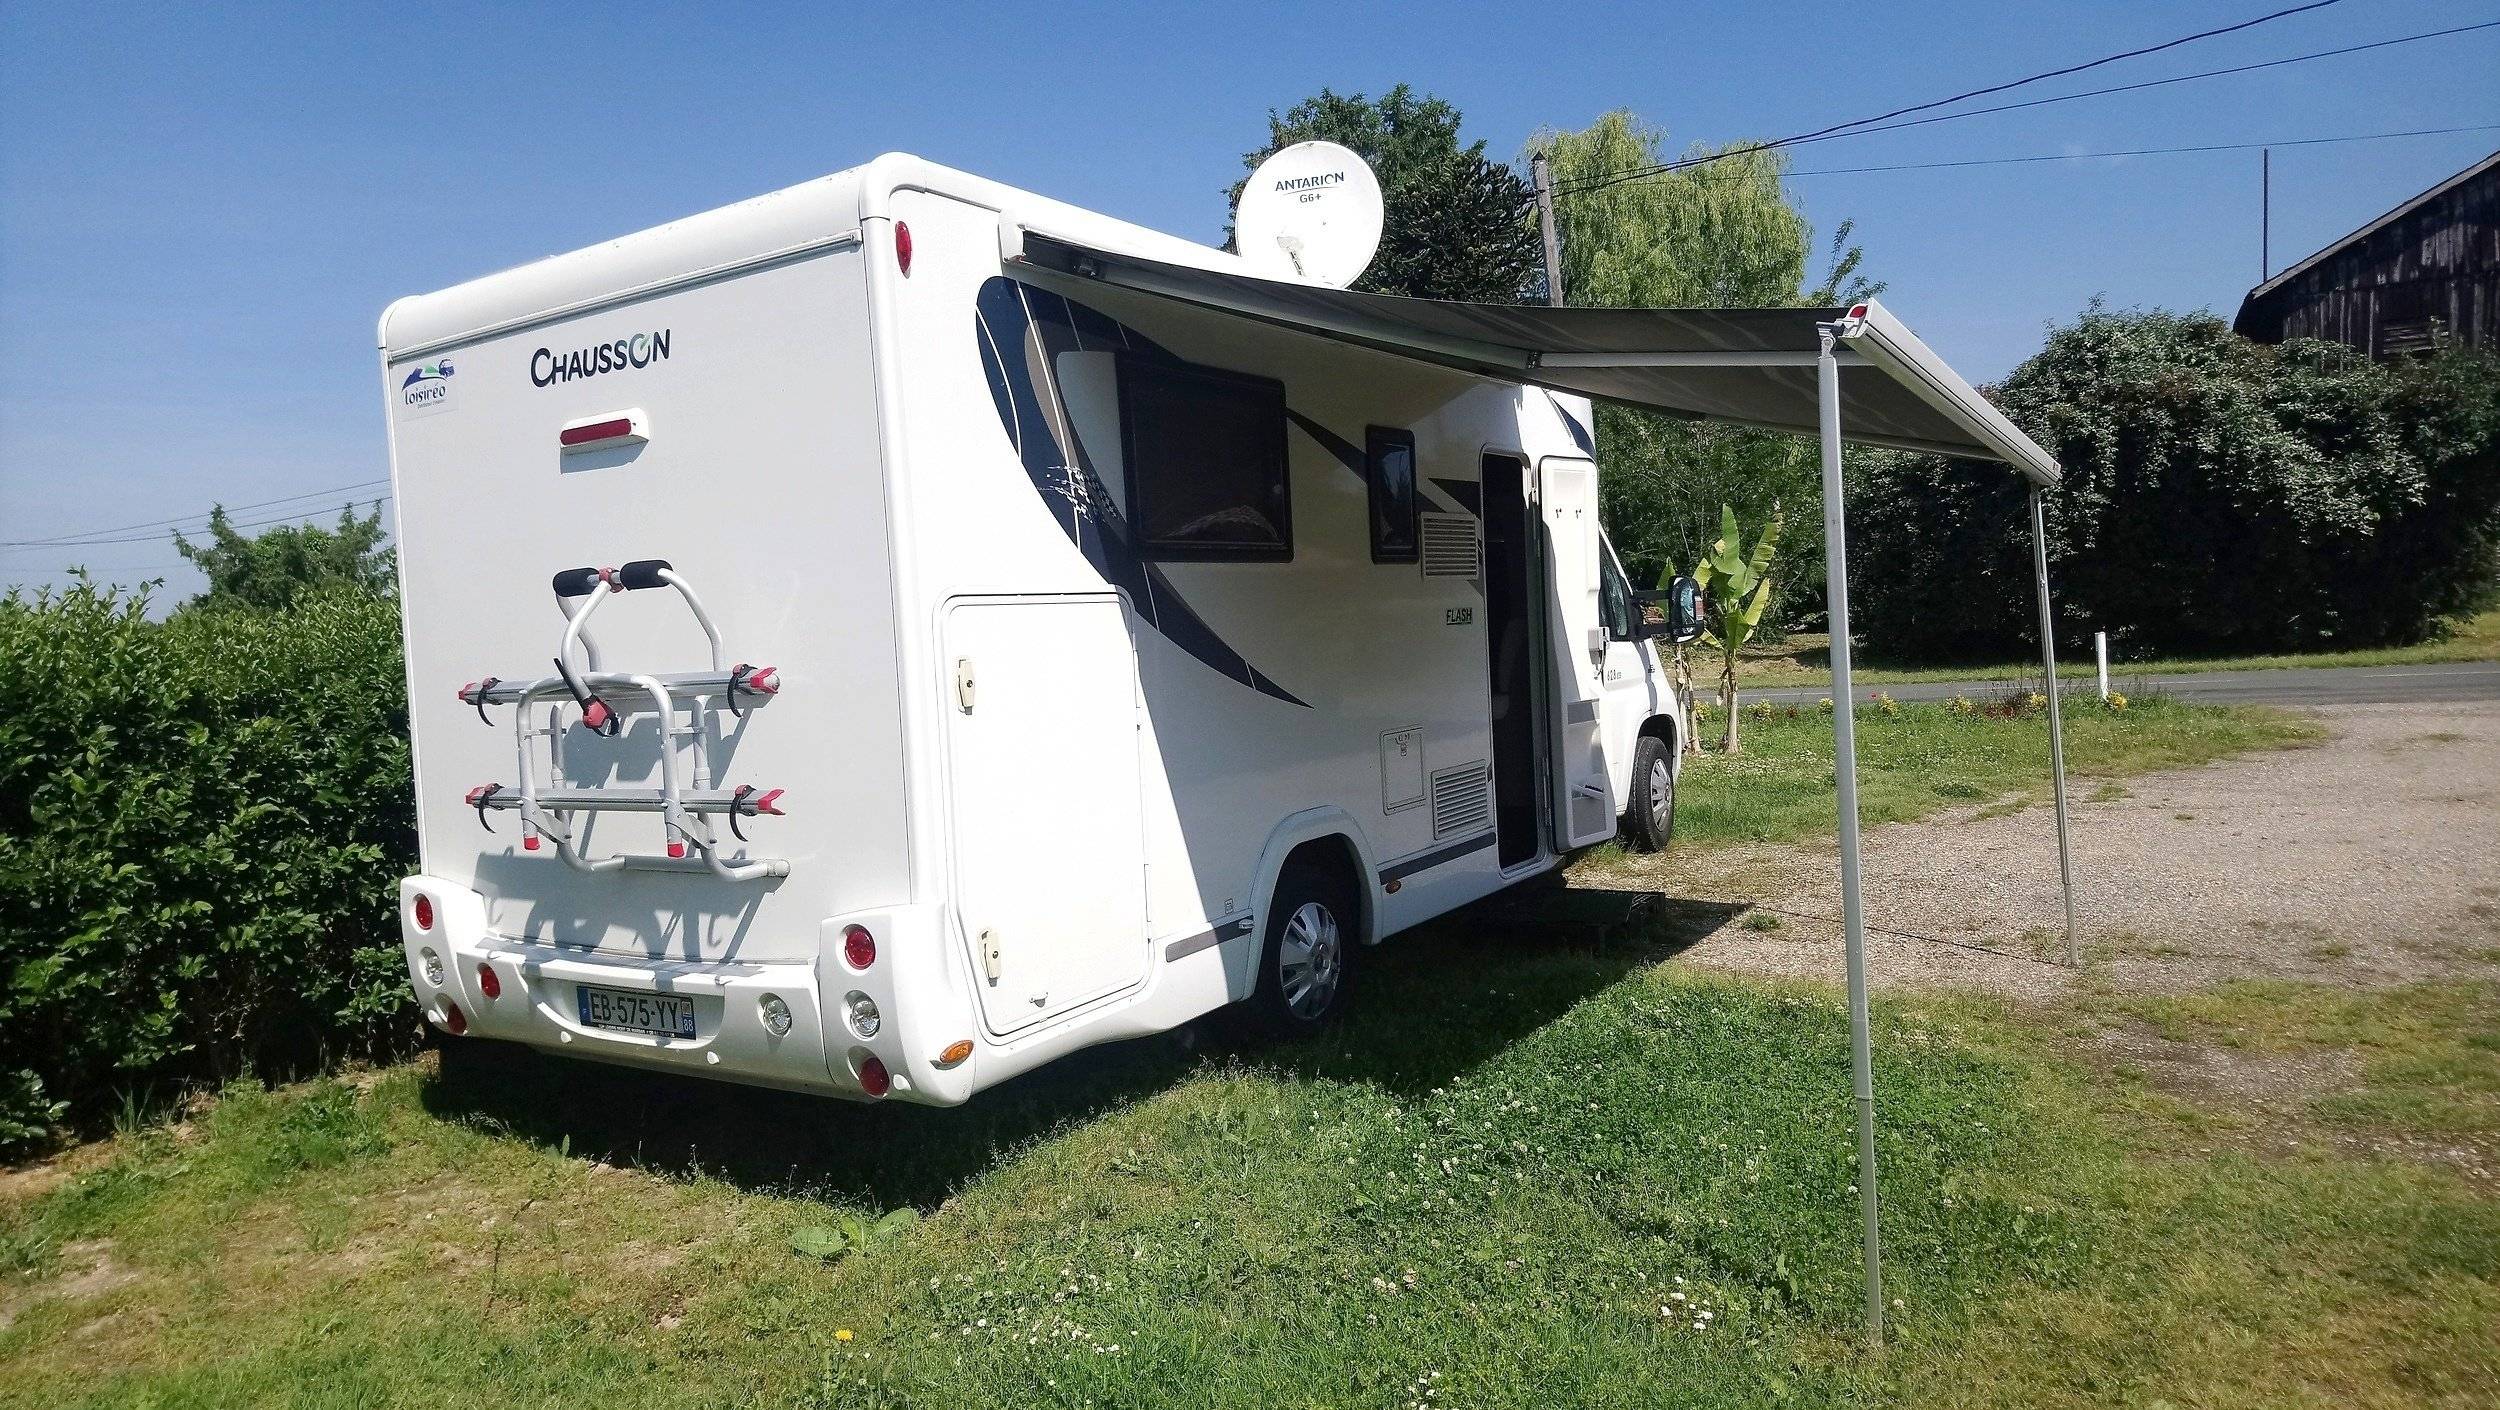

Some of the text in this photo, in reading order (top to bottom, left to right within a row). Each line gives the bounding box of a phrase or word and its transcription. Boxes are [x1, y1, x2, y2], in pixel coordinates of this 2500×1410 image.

[1275, 171, 1345, 192] ANTARION
[1299, 193, 1322, 204] G6+
[531, 329, 671, 388] CHAUSSON
[1446, 607, 1472, 623] FLASH
[589, 992, 678, 1029] EB-575-YY
